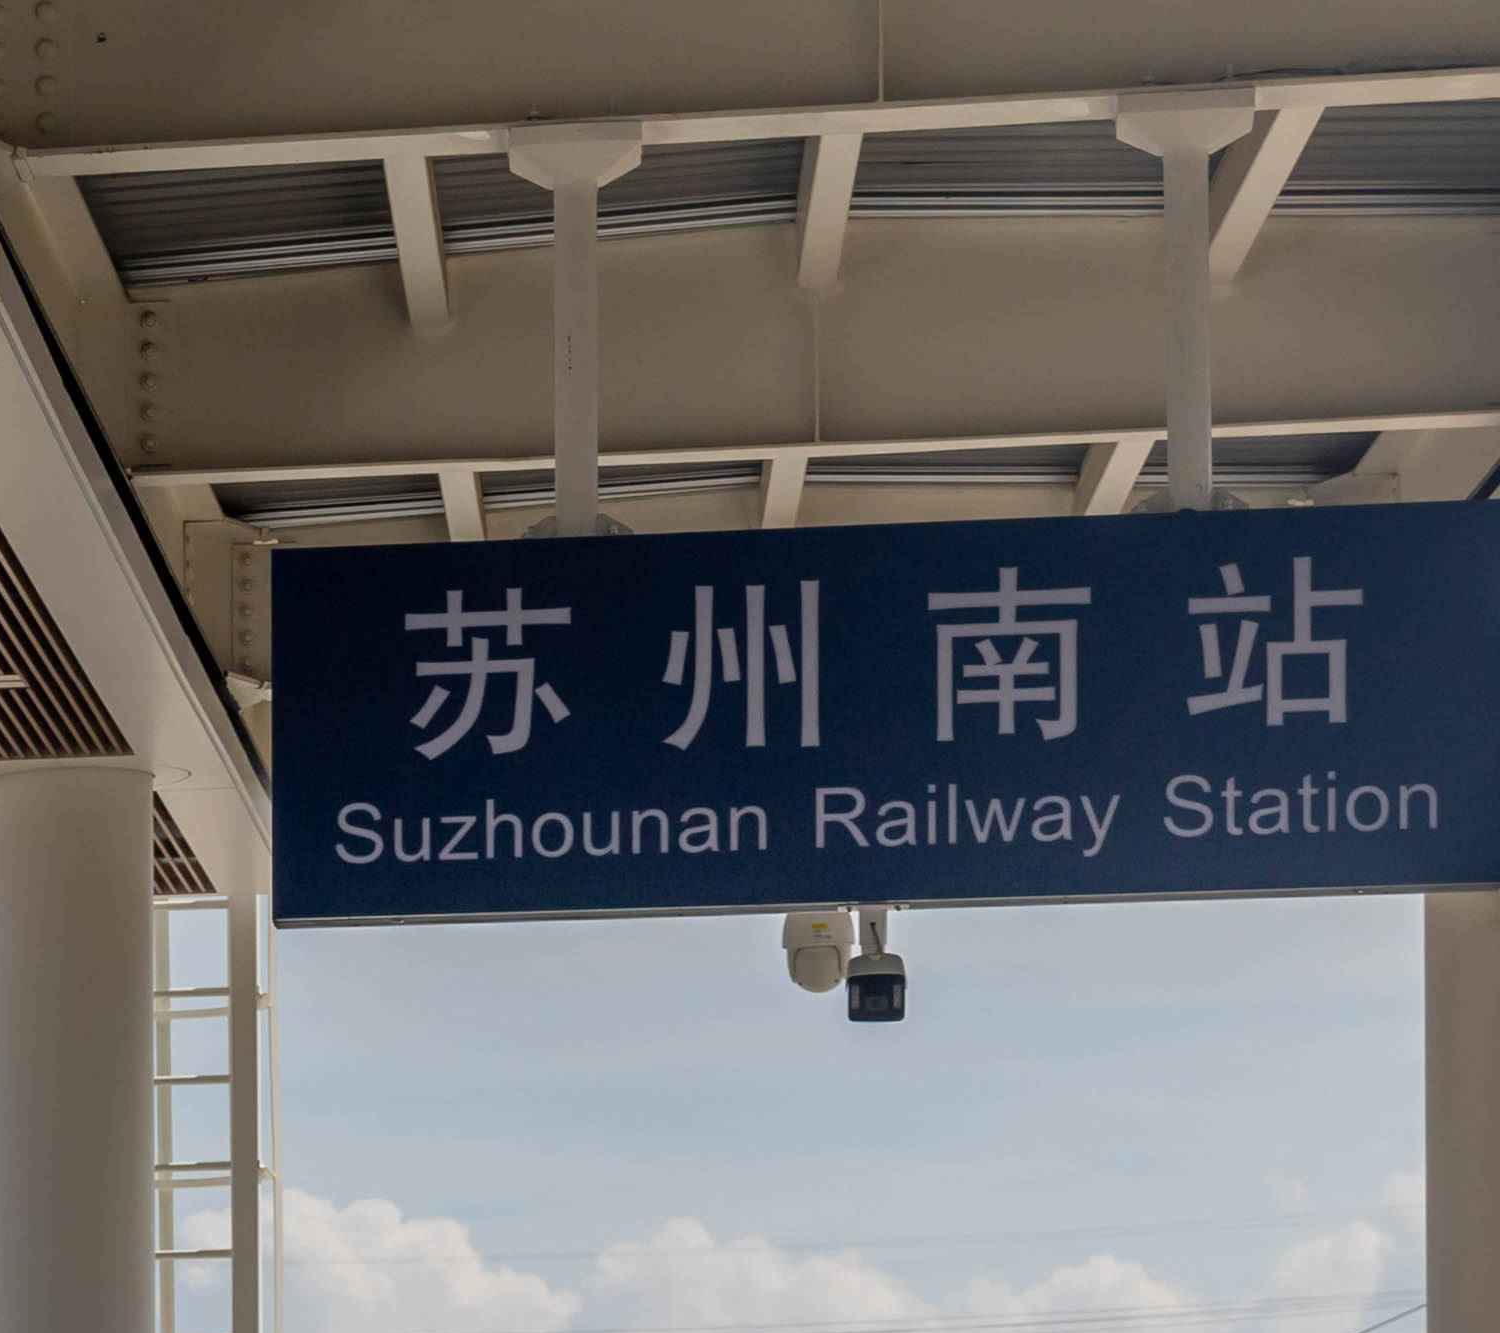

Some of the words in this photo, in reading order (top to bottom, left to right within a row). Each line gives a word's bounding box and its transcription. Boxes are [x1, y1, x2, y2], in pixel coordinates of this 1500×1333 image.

[405, 557, 1364, 761] 苏州南站
[335, 798, 768, 864] Suzhounan
[814, 784, 1121, 857] Railway
[1162, 770, 1438, 838] Station
